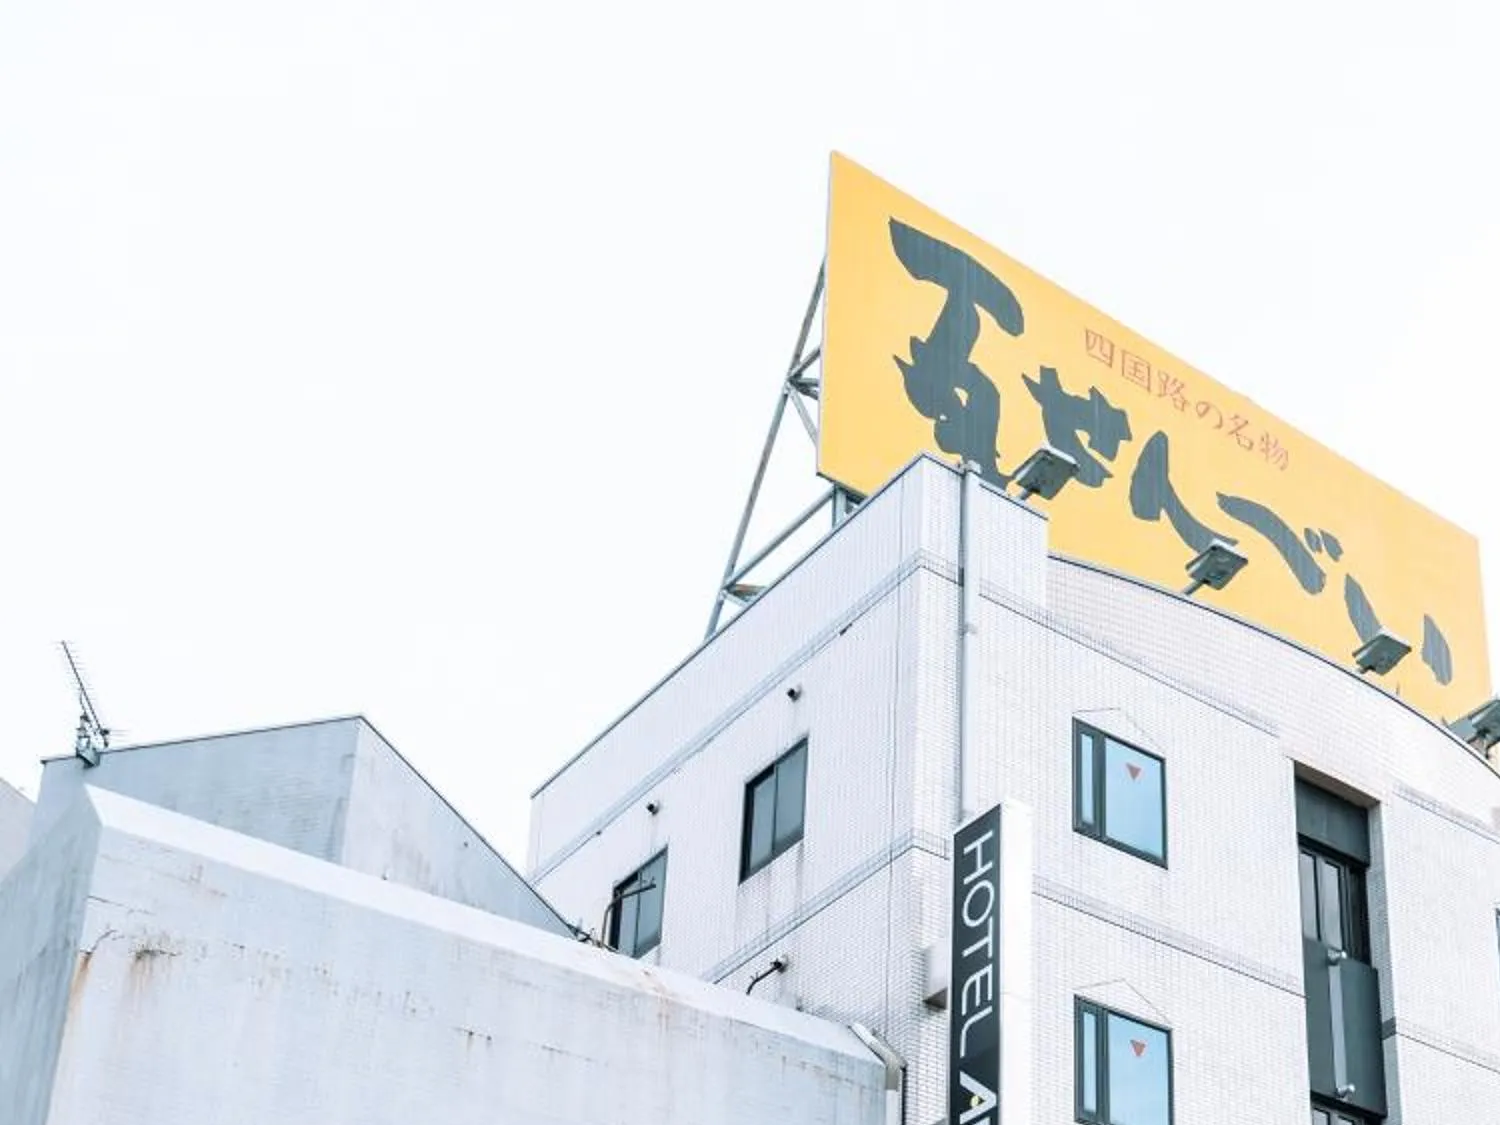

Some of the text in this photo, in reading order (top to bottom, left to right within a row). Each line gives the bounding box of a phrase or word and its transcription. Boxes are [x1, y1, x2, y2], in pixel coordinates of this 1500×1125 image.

[1084, 328, 1290, 472] 四国路の名物
[962, 830, 994, 1058] HOTEL
